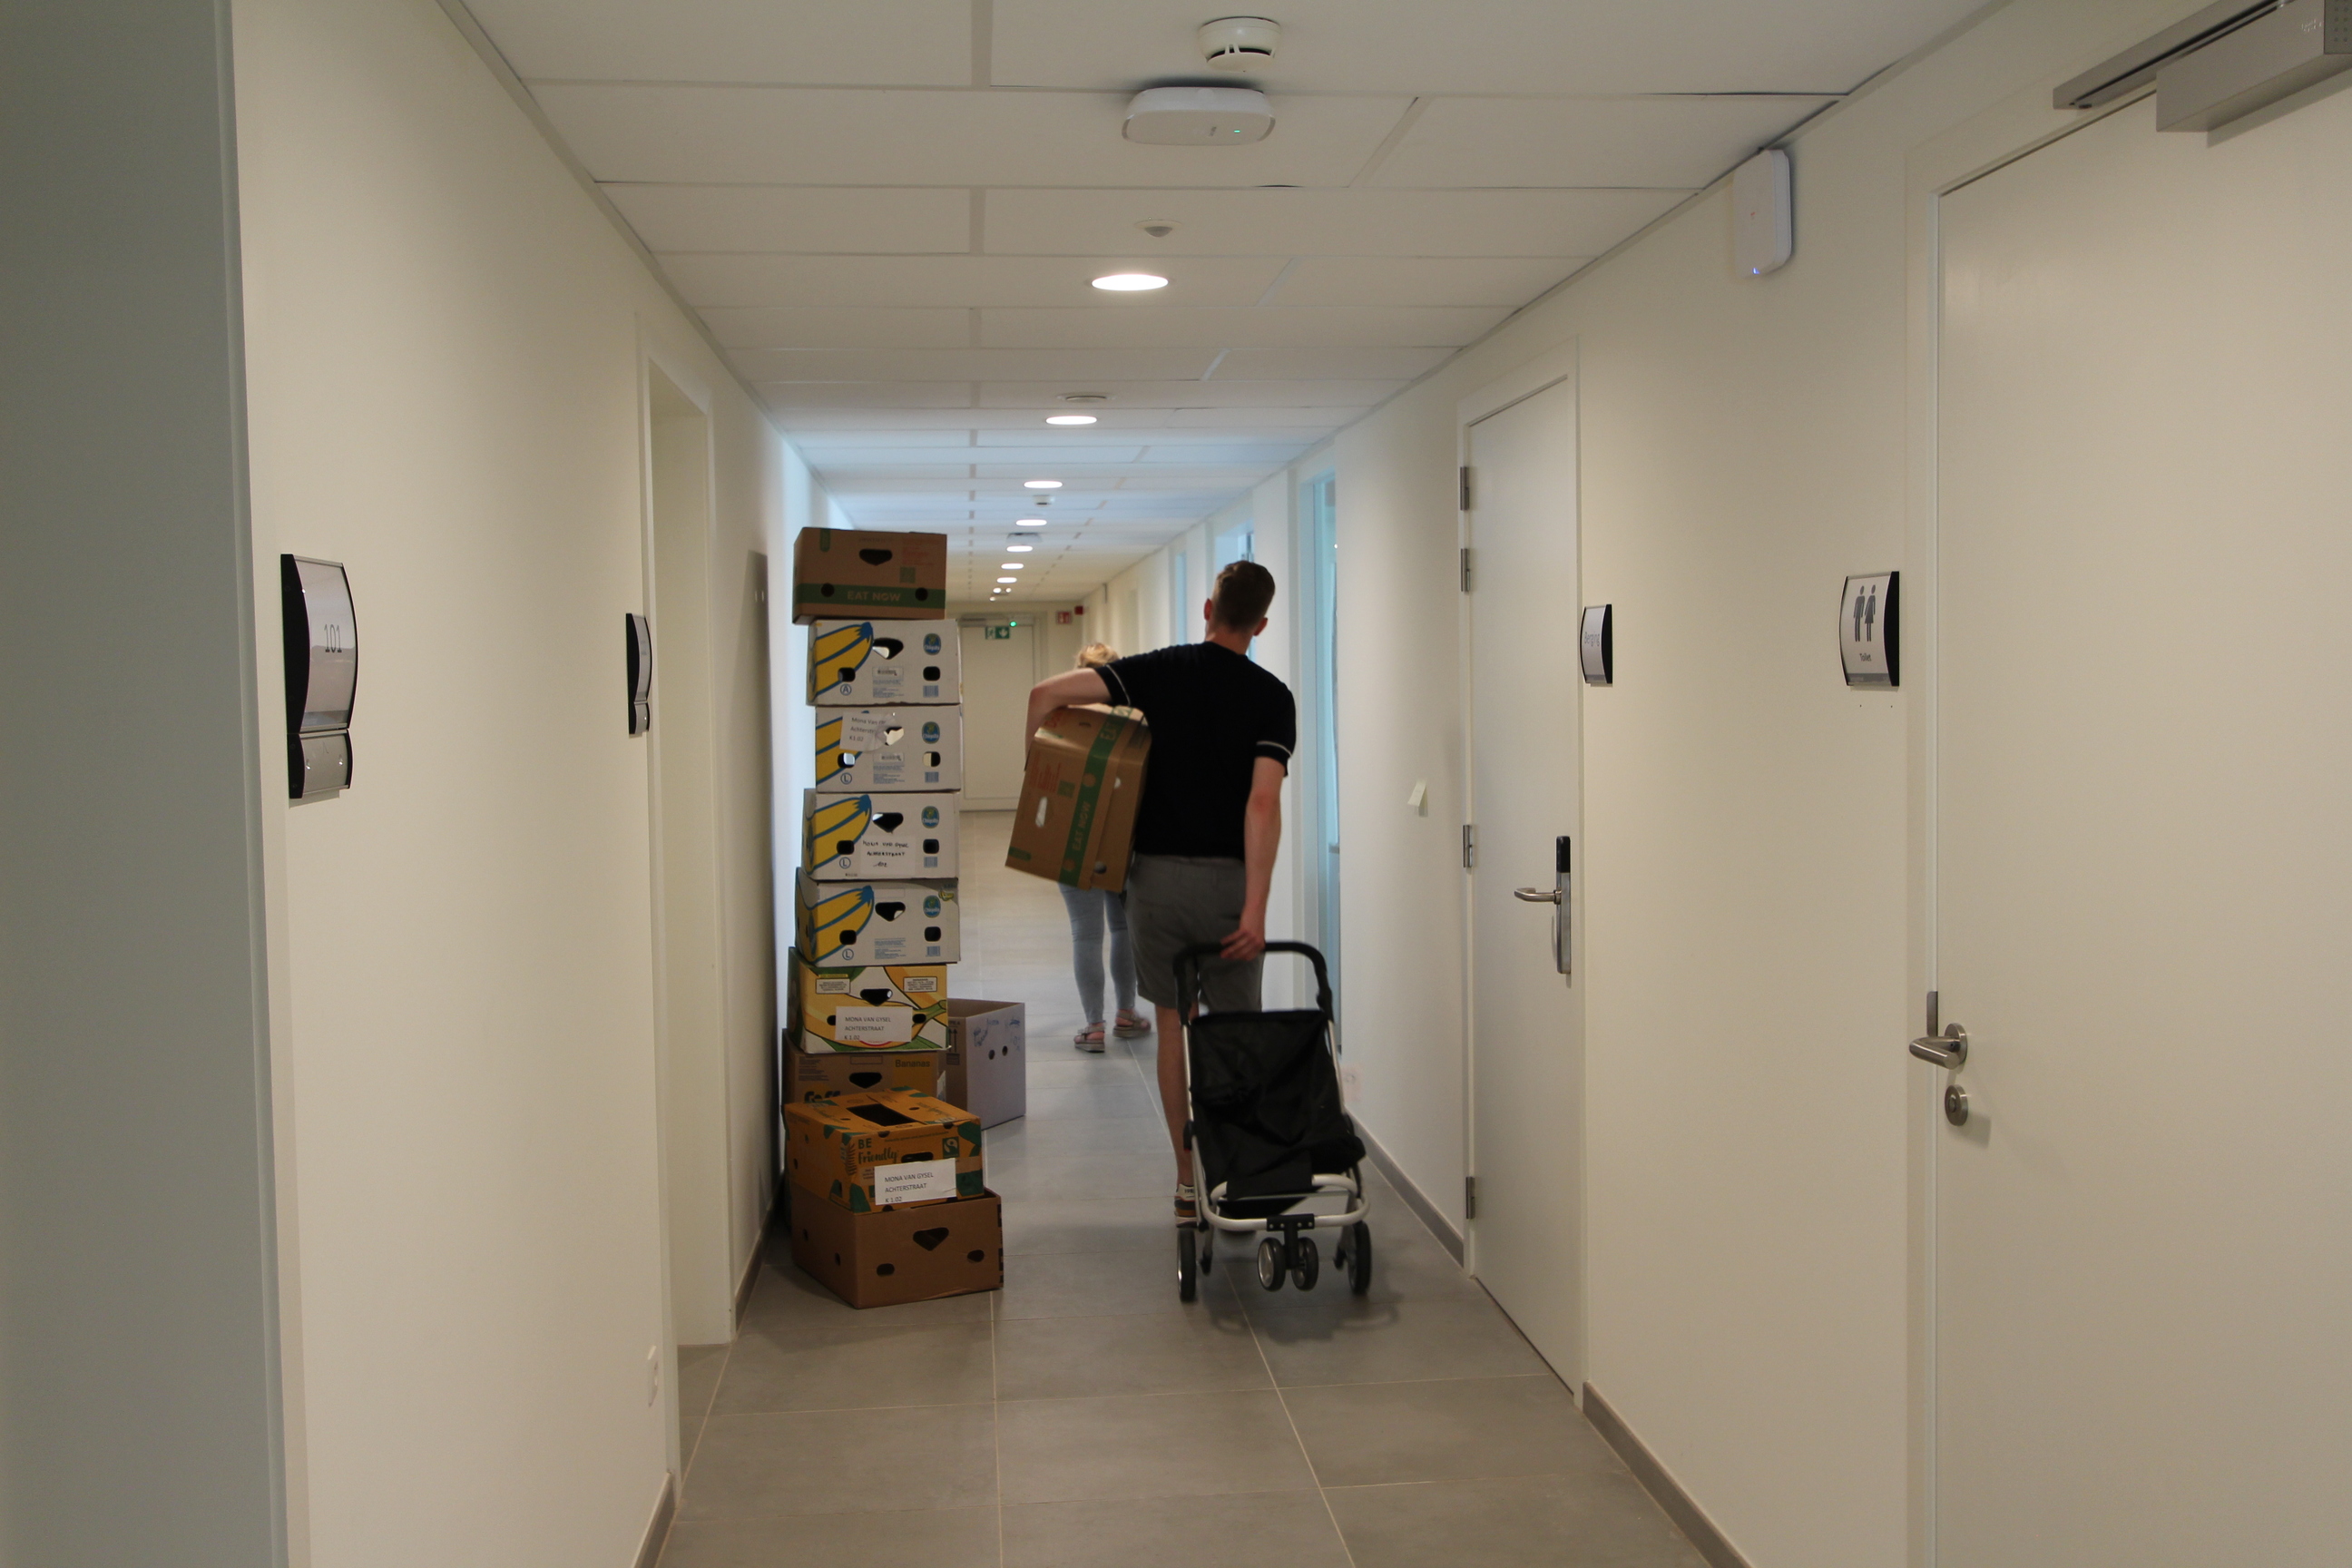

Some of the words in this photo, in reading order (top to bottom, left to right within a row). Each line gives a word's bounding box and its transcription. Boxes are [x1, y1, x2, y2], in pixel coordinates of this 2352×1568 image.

[847, 591, 869, 601] EAT
[872, 593, 901, 602] NOW
[324, 623, 342, 653] 101
[1858, 652, 1872, 662] Toilet
[895, 1059, 931, 1069] Bananas
[858, 1138, 872, 1149] BE
[858, 1147, 897, 1164] Friendly
[916, 1171, 934, 1180] GYSEL
[885, 1182, 927, 1193] ACHTERSTRAAT
